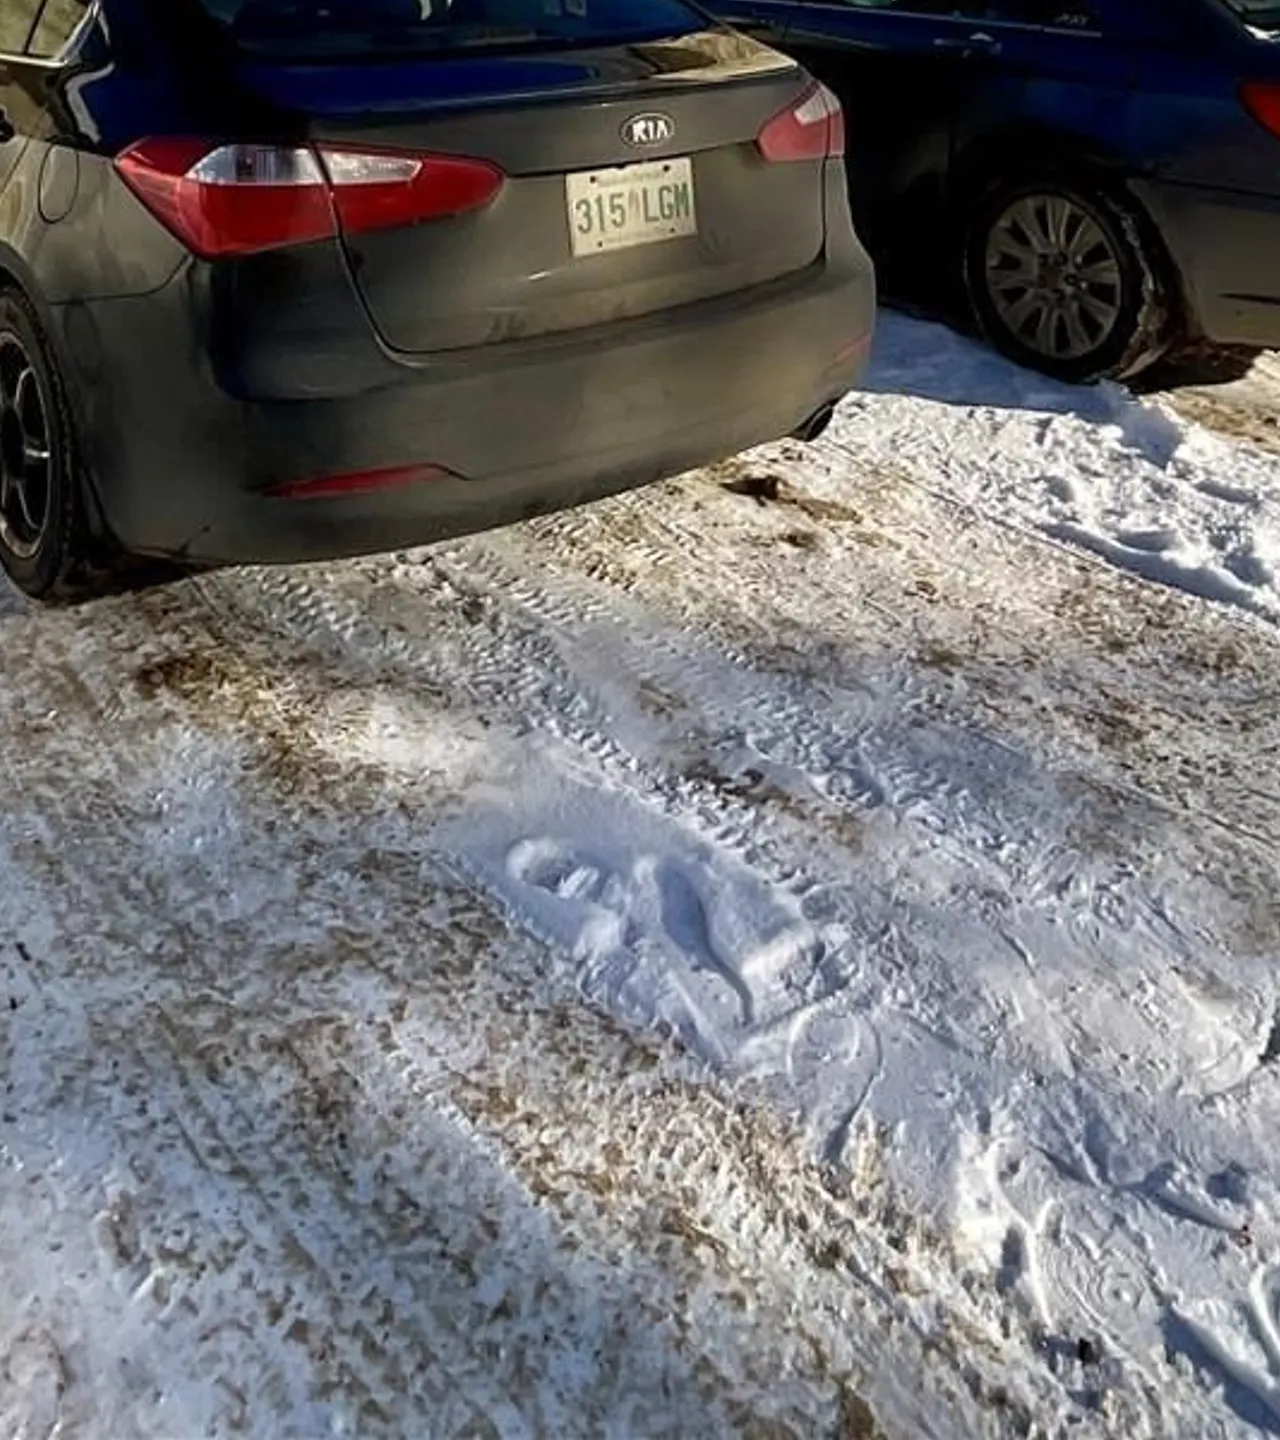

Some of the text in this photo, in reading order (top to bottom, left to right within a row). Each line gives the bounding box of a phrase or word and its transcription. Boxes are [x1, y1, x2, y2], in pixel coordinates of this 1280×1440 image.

[632, 120, 668, 142] KIA
[575, 192, 626, 234] 315
[642, 182, 690, 223] LGM
